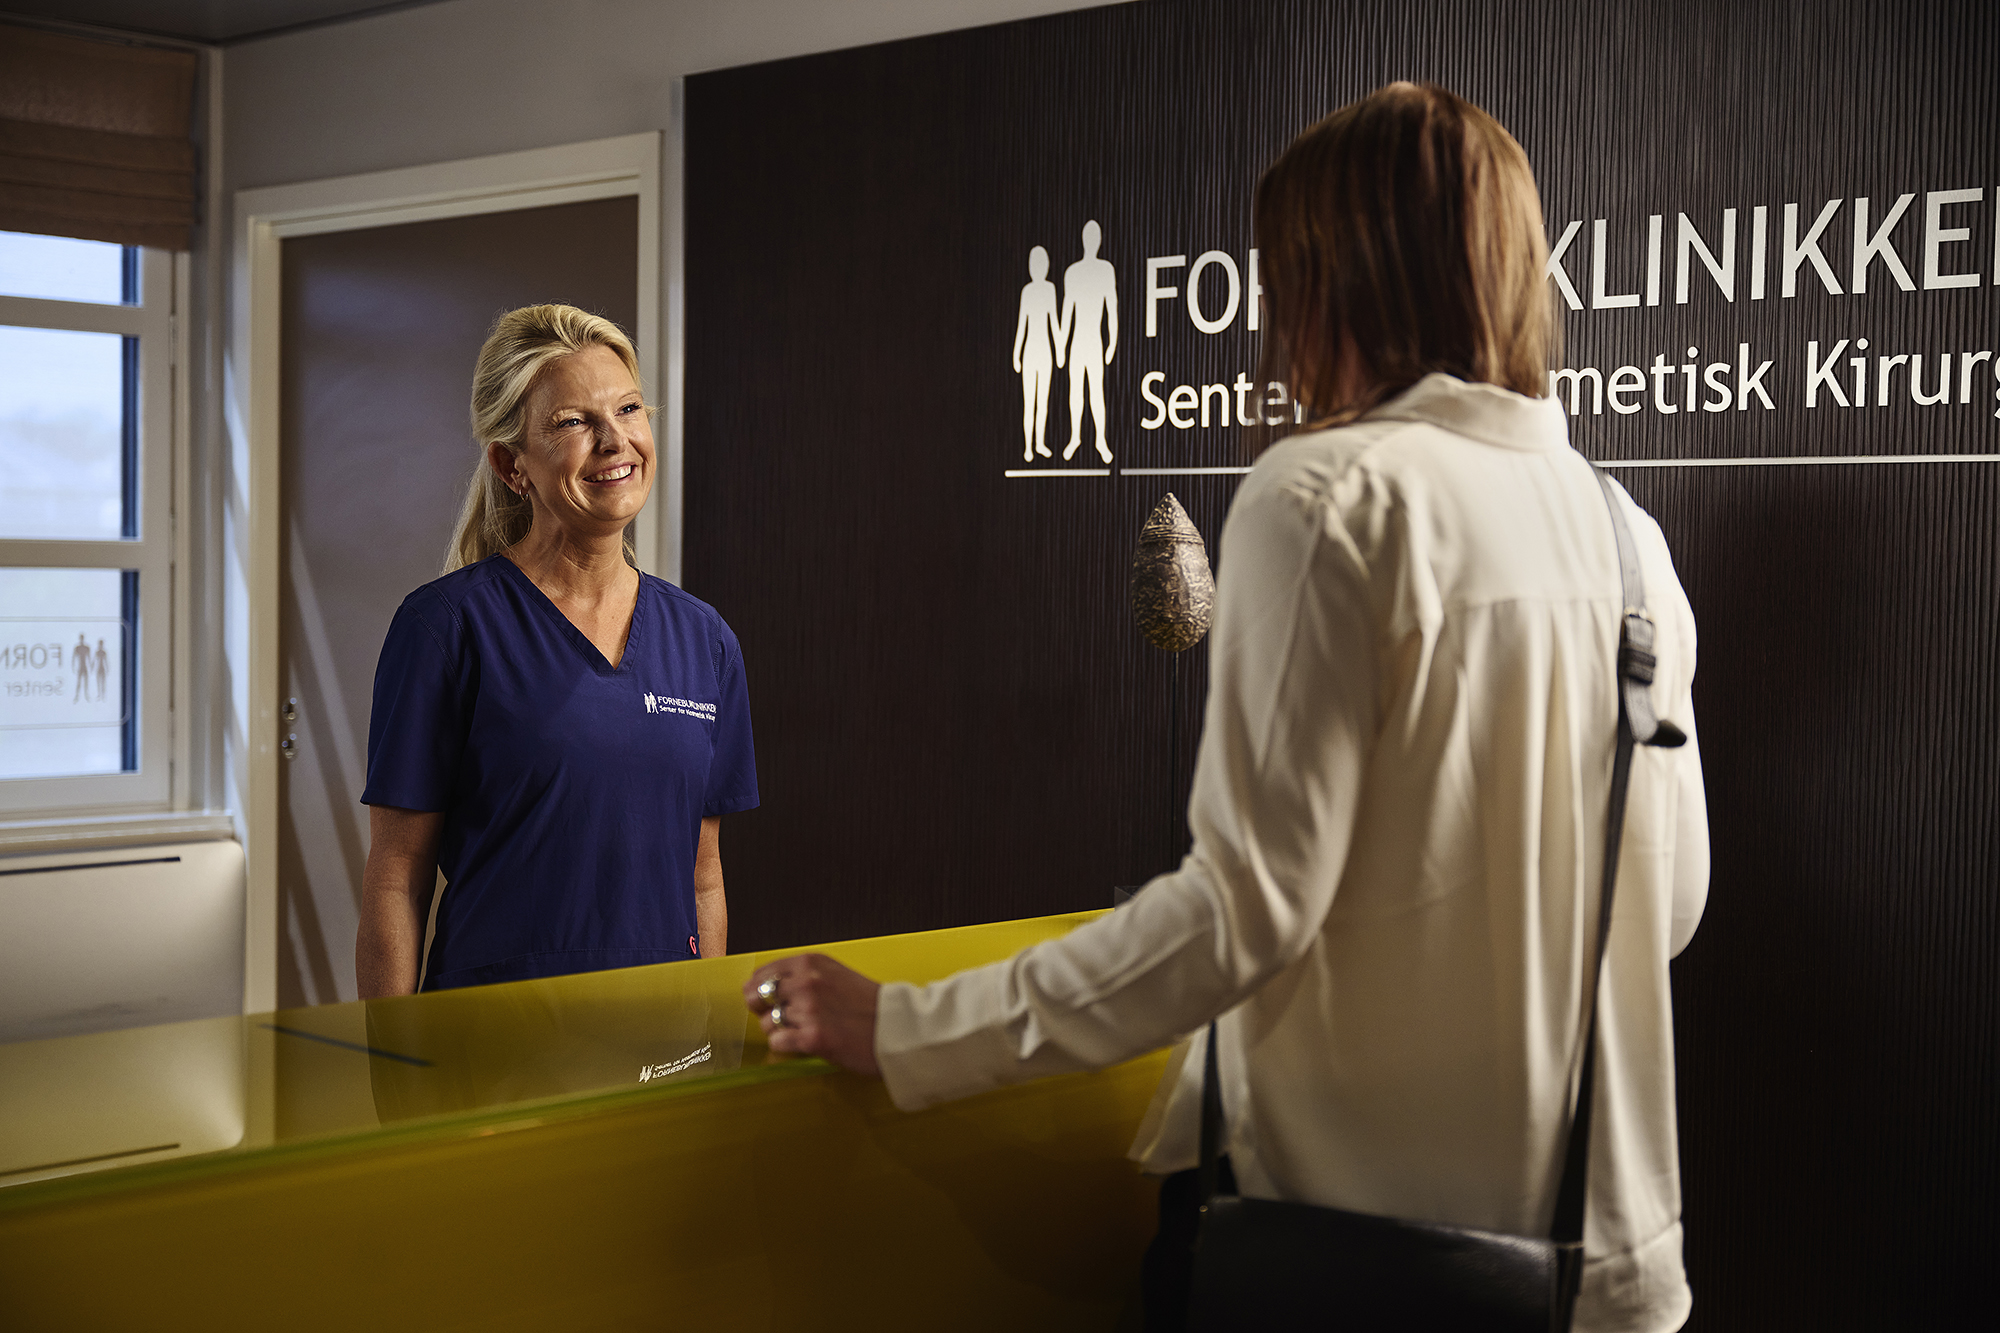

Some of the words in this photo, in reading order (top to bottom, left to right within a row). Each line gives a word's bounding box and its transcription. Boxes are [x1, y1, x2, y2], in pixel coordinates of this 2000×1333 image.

[1544, 186, 2000, 311] KLINIKKE
[1549, 343, 1776, 416] metisk
[1806, 338, 2000, 419] Kirur
